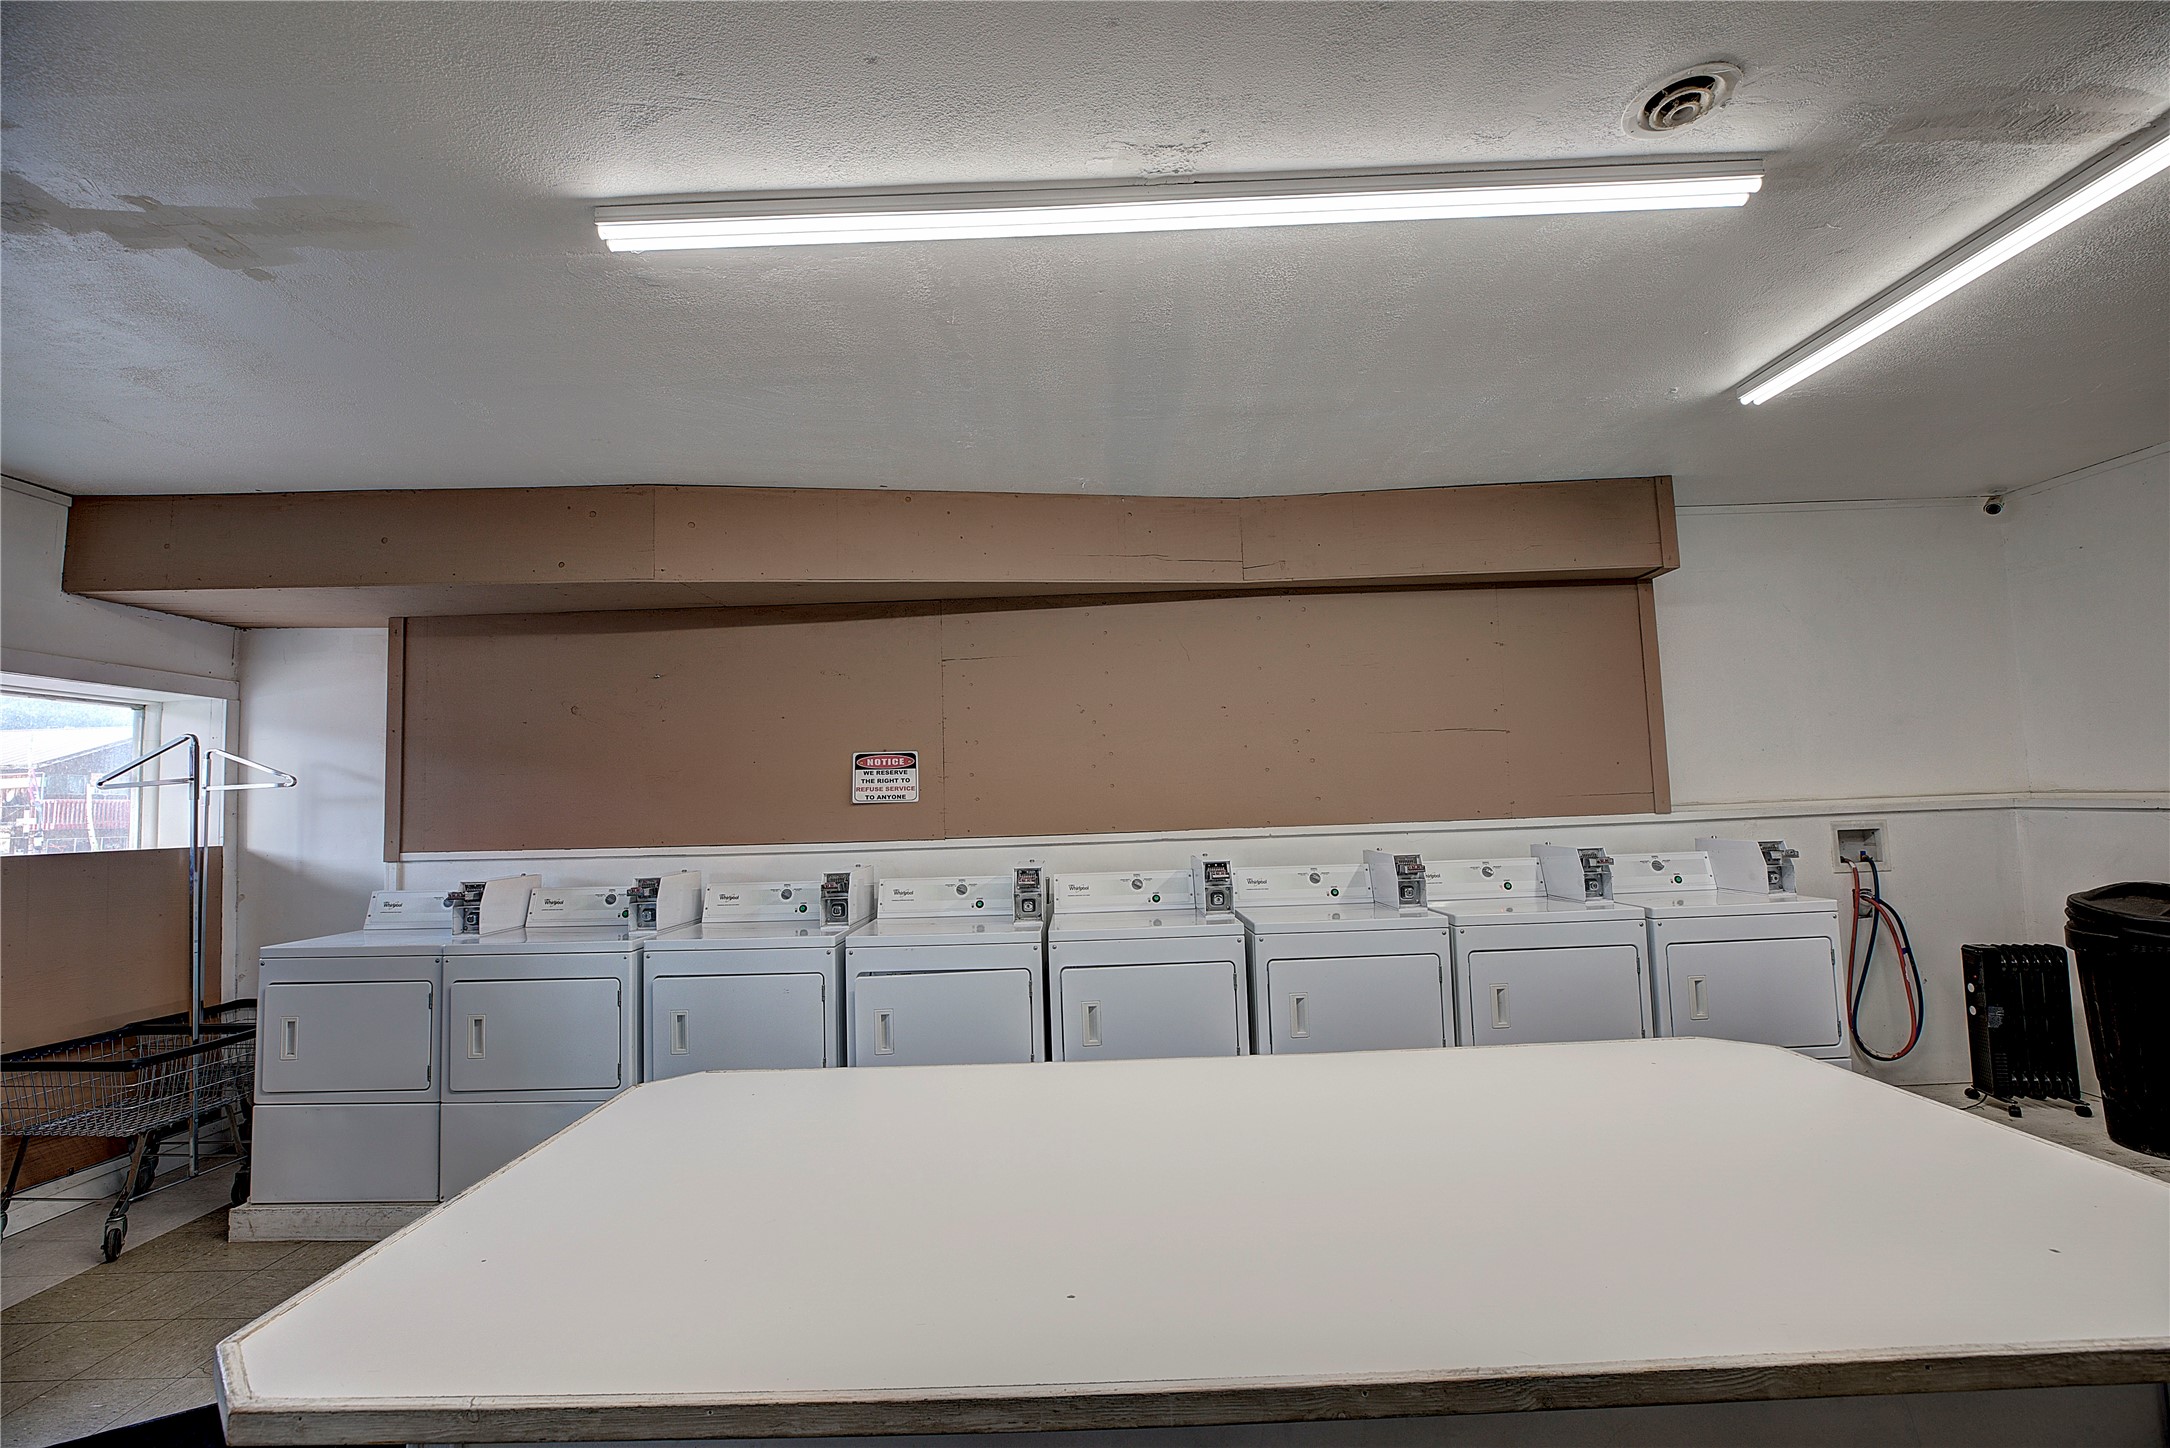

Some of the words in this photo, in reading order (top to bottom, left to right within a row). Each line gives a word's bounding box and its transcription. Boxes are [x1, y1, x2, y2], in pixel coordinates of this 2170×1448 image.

[867, 758, 904, 766] NOTICE
[1246, 877, 1267, 886] Whirlpool
[1068, 884, 1089, 892] Whirlpool
[893, 889, 914, 897] Whirlpool
[719, 894, 740, 902] Whirlpool
[383, 900, 403, 909] Whirlpool
[544, 898, 565, 907] Whirlpool
